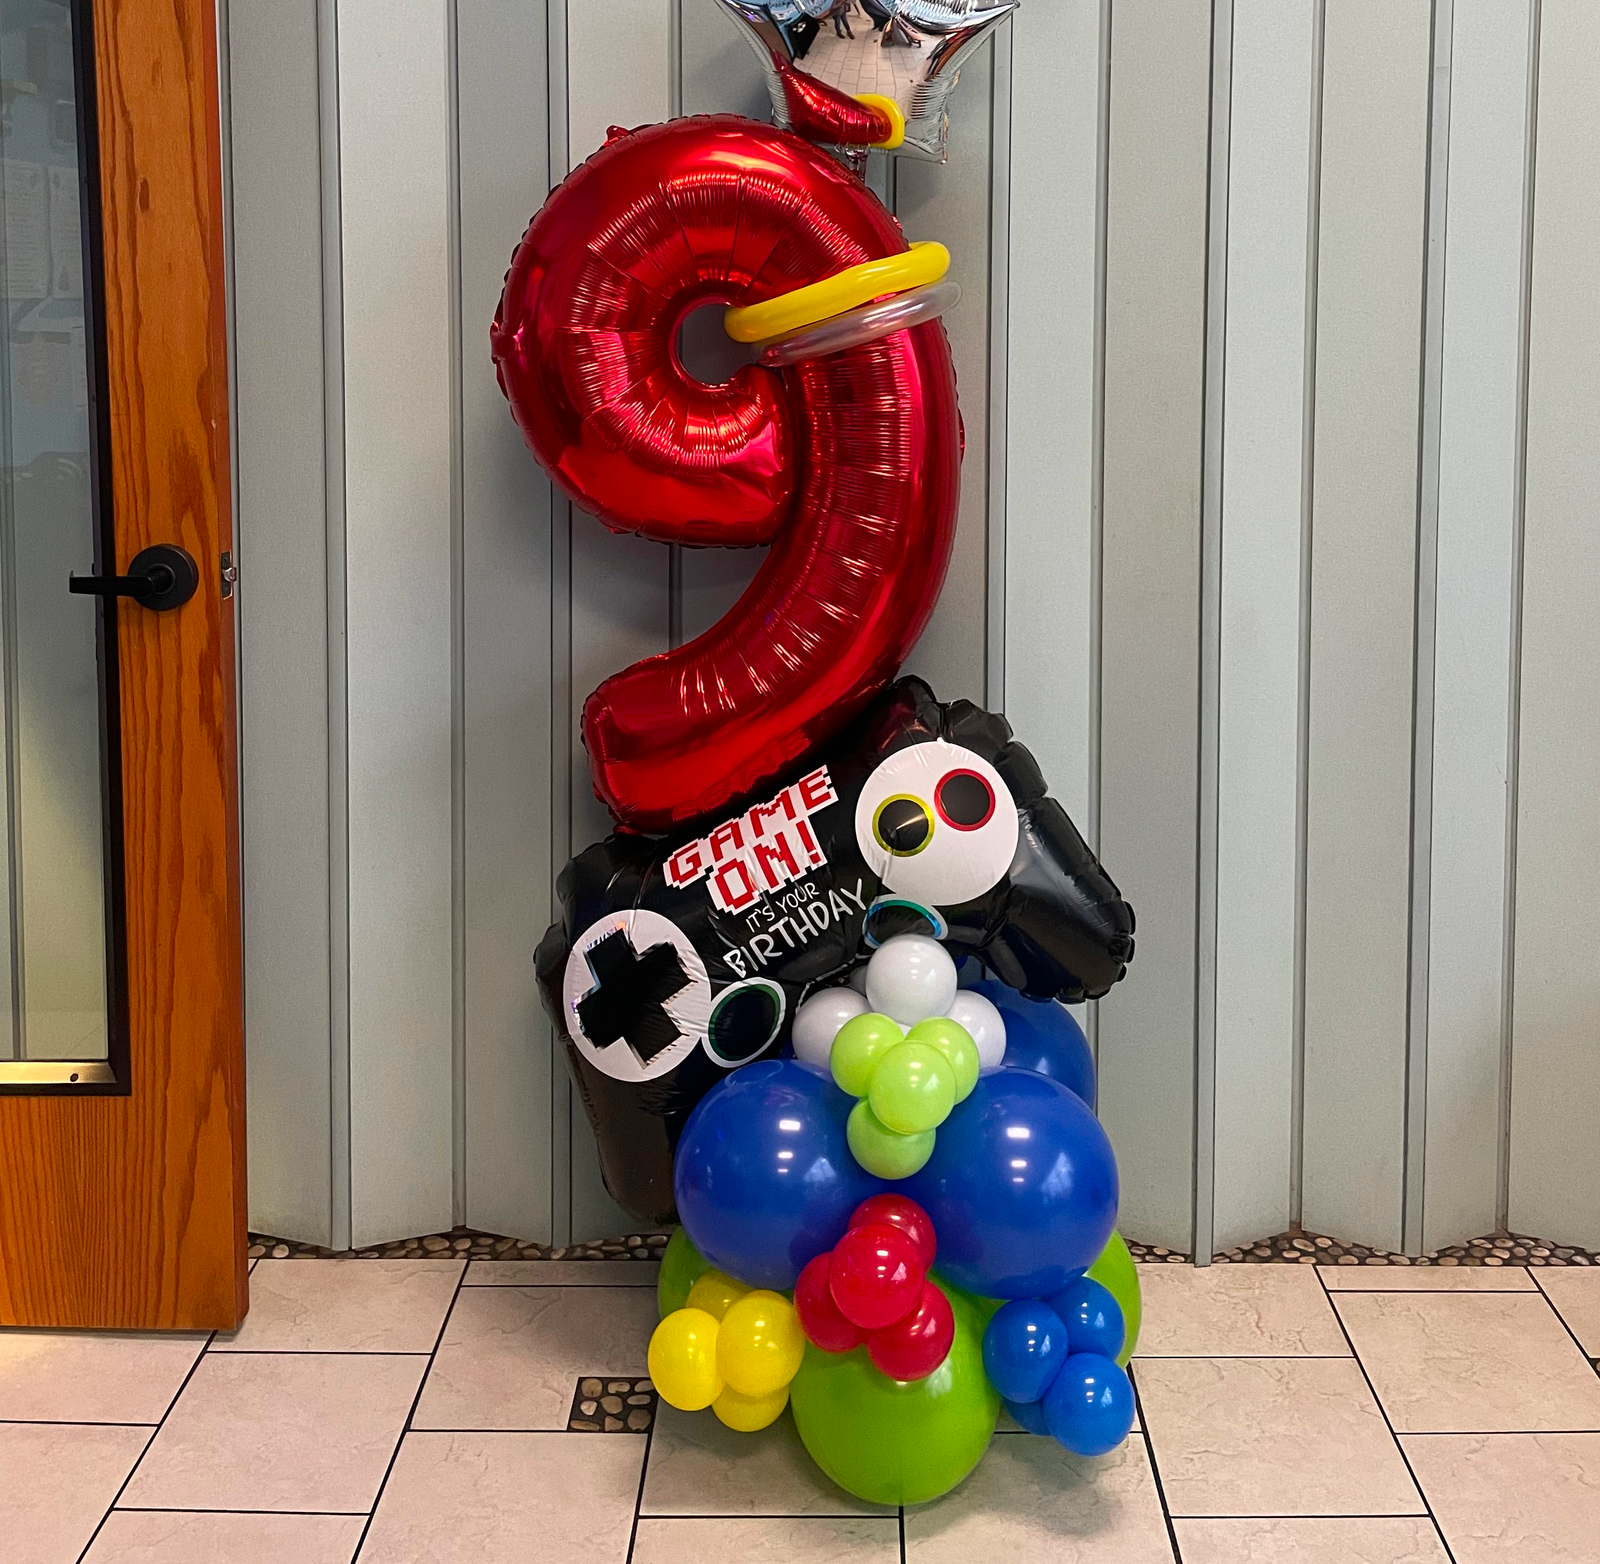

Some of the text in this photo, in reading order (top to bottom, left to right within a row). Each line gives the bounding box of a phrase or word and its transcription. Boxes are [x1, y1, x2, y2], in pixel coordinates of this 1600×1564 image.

[490, 113, 964, 834] 9
[667, 768, 833, 885] GAME
[714, 819, 821, 910] ON!
[722, 877, 867, 979] BIRTHDAY
[745, 882, 820, 933] IT'S YOUR
